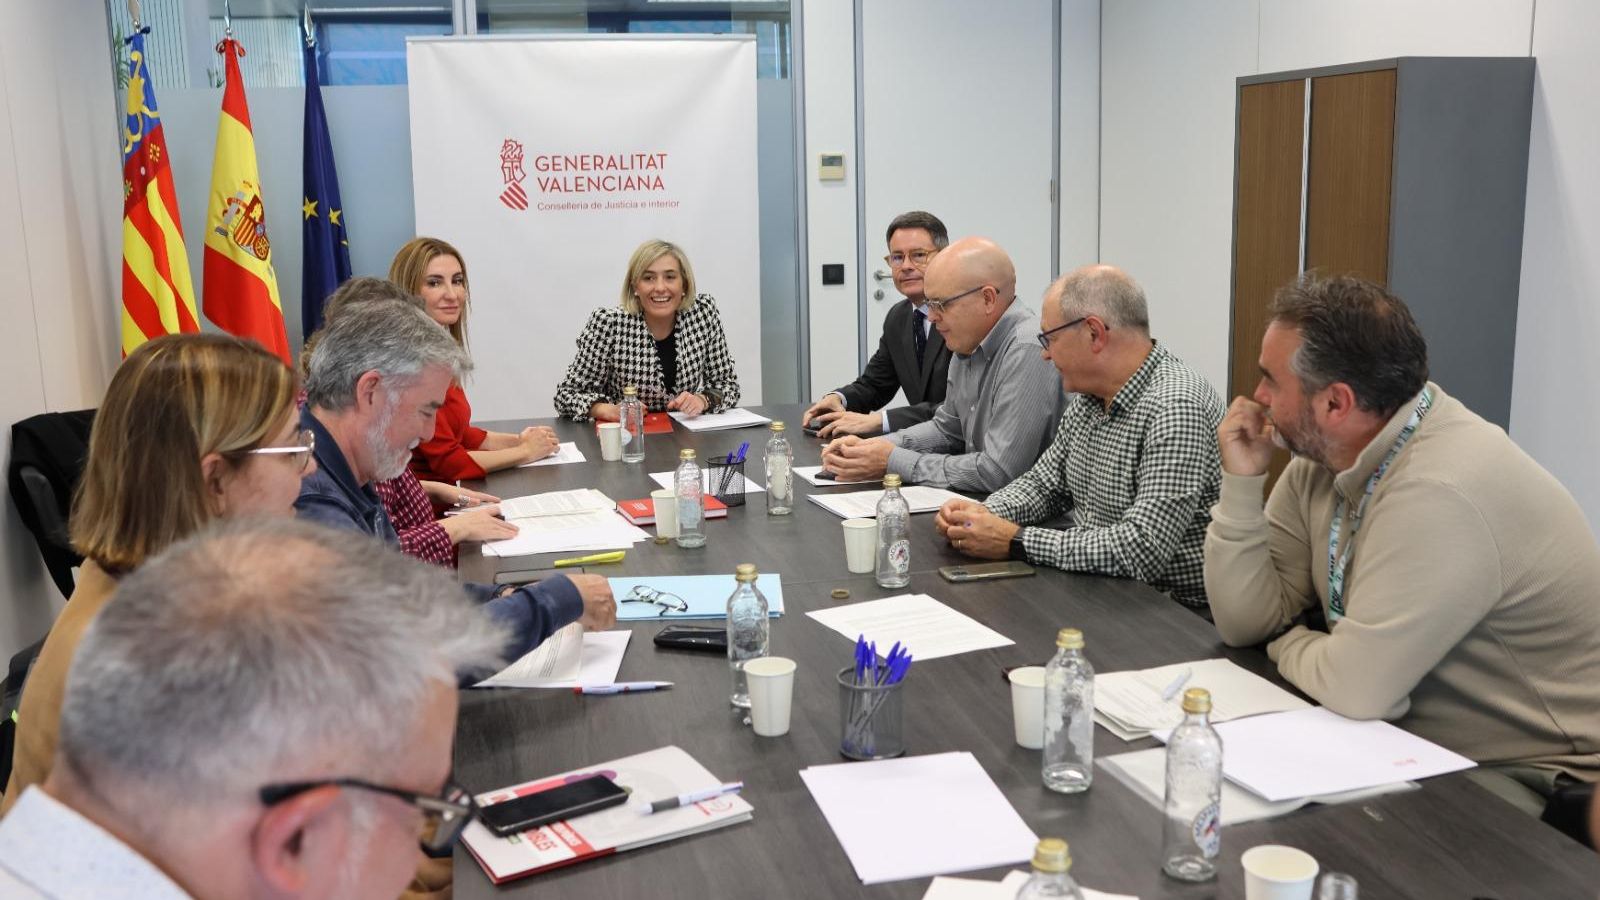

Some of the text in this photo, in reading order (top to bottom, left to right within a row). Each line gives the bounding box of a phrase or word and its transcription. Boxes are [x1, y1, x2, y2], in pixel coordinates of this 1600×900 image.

[535, 153, 668, 172] GENERALITAT
[537, 175, 665, 193] VALENCIANA
[537, 202, 589, 212] Conselleria
[590, 202, 603, 211] de
[604, 201, 638, 210] Justicia
